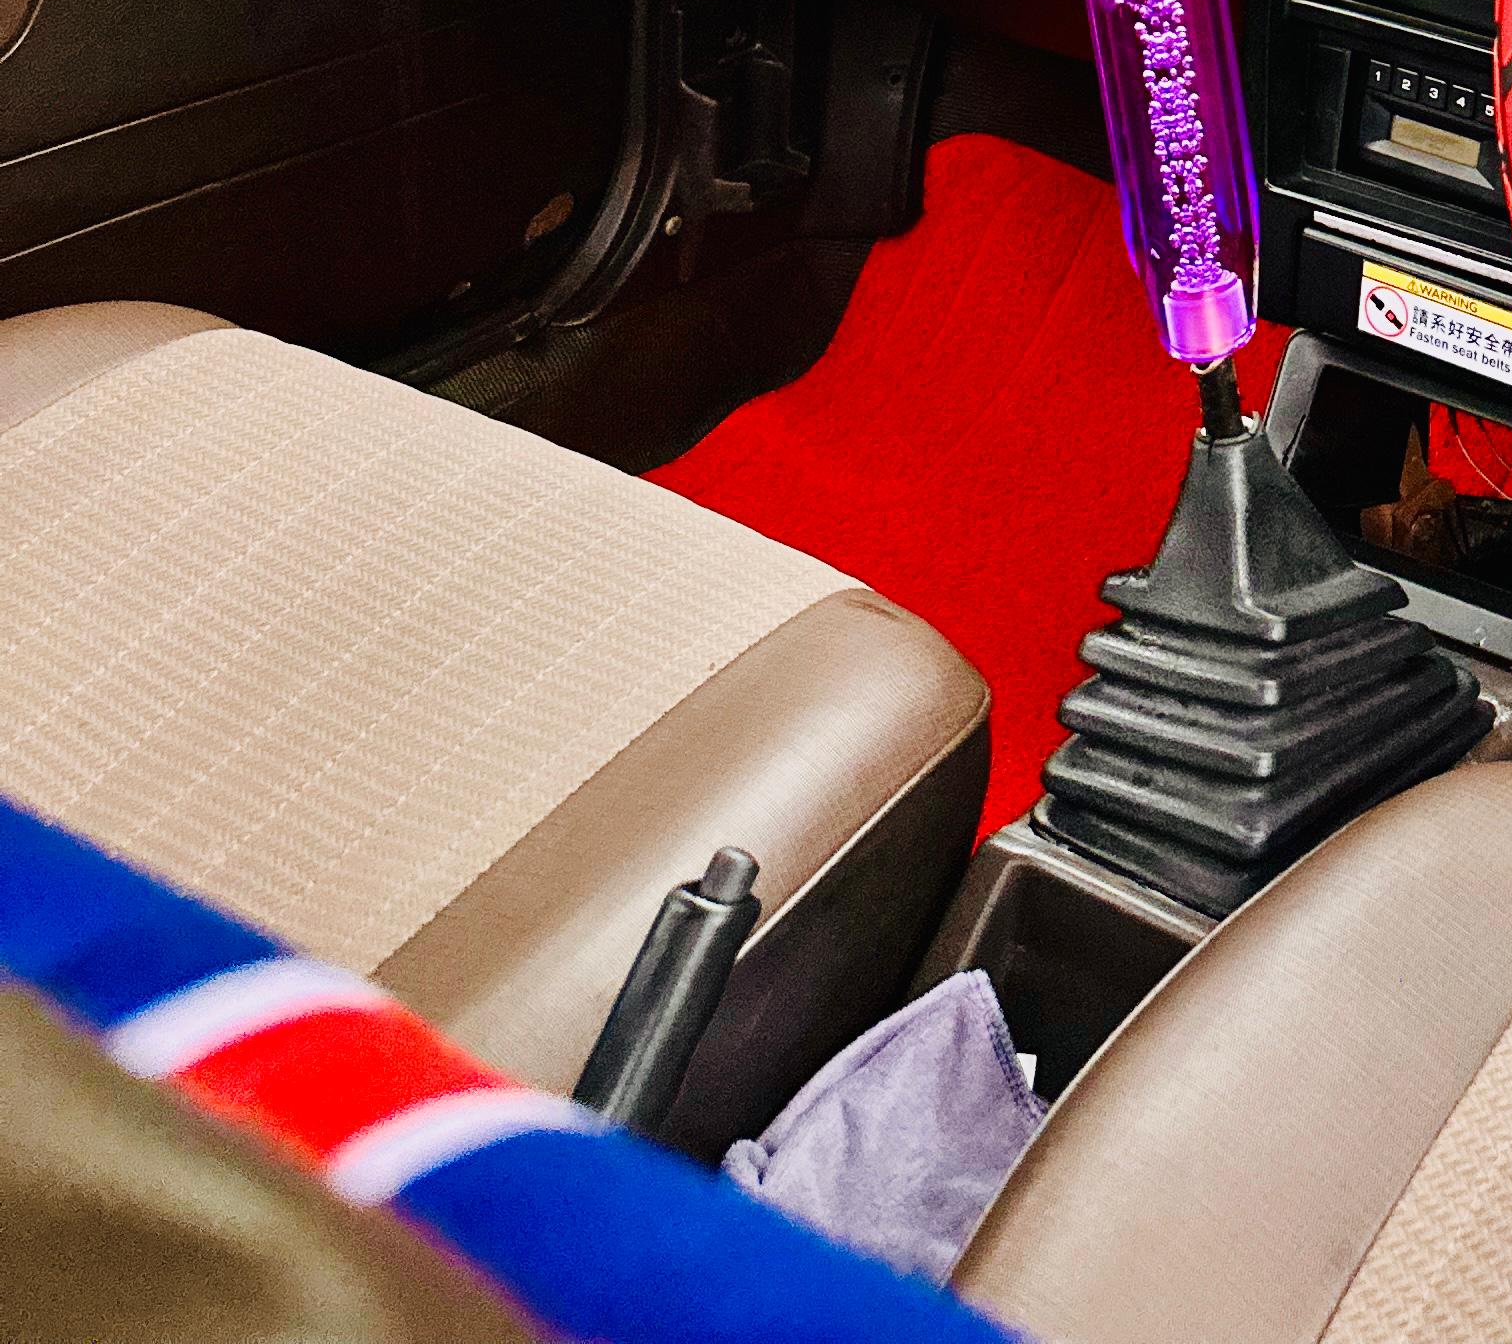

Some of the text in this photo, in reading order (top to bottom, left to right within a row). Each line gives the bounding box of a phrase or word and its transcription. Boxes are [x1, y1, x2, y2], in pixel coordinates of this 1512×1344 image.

[1374, 70, 1495, 117] 1 2 3 4 5
[1419, 284, 1479, 314] WARNING
[1408, 326, 1449, 351] Fasten
[1452, 342, 1479, 361] seat
[1481, 352, 1512, 374] belts
